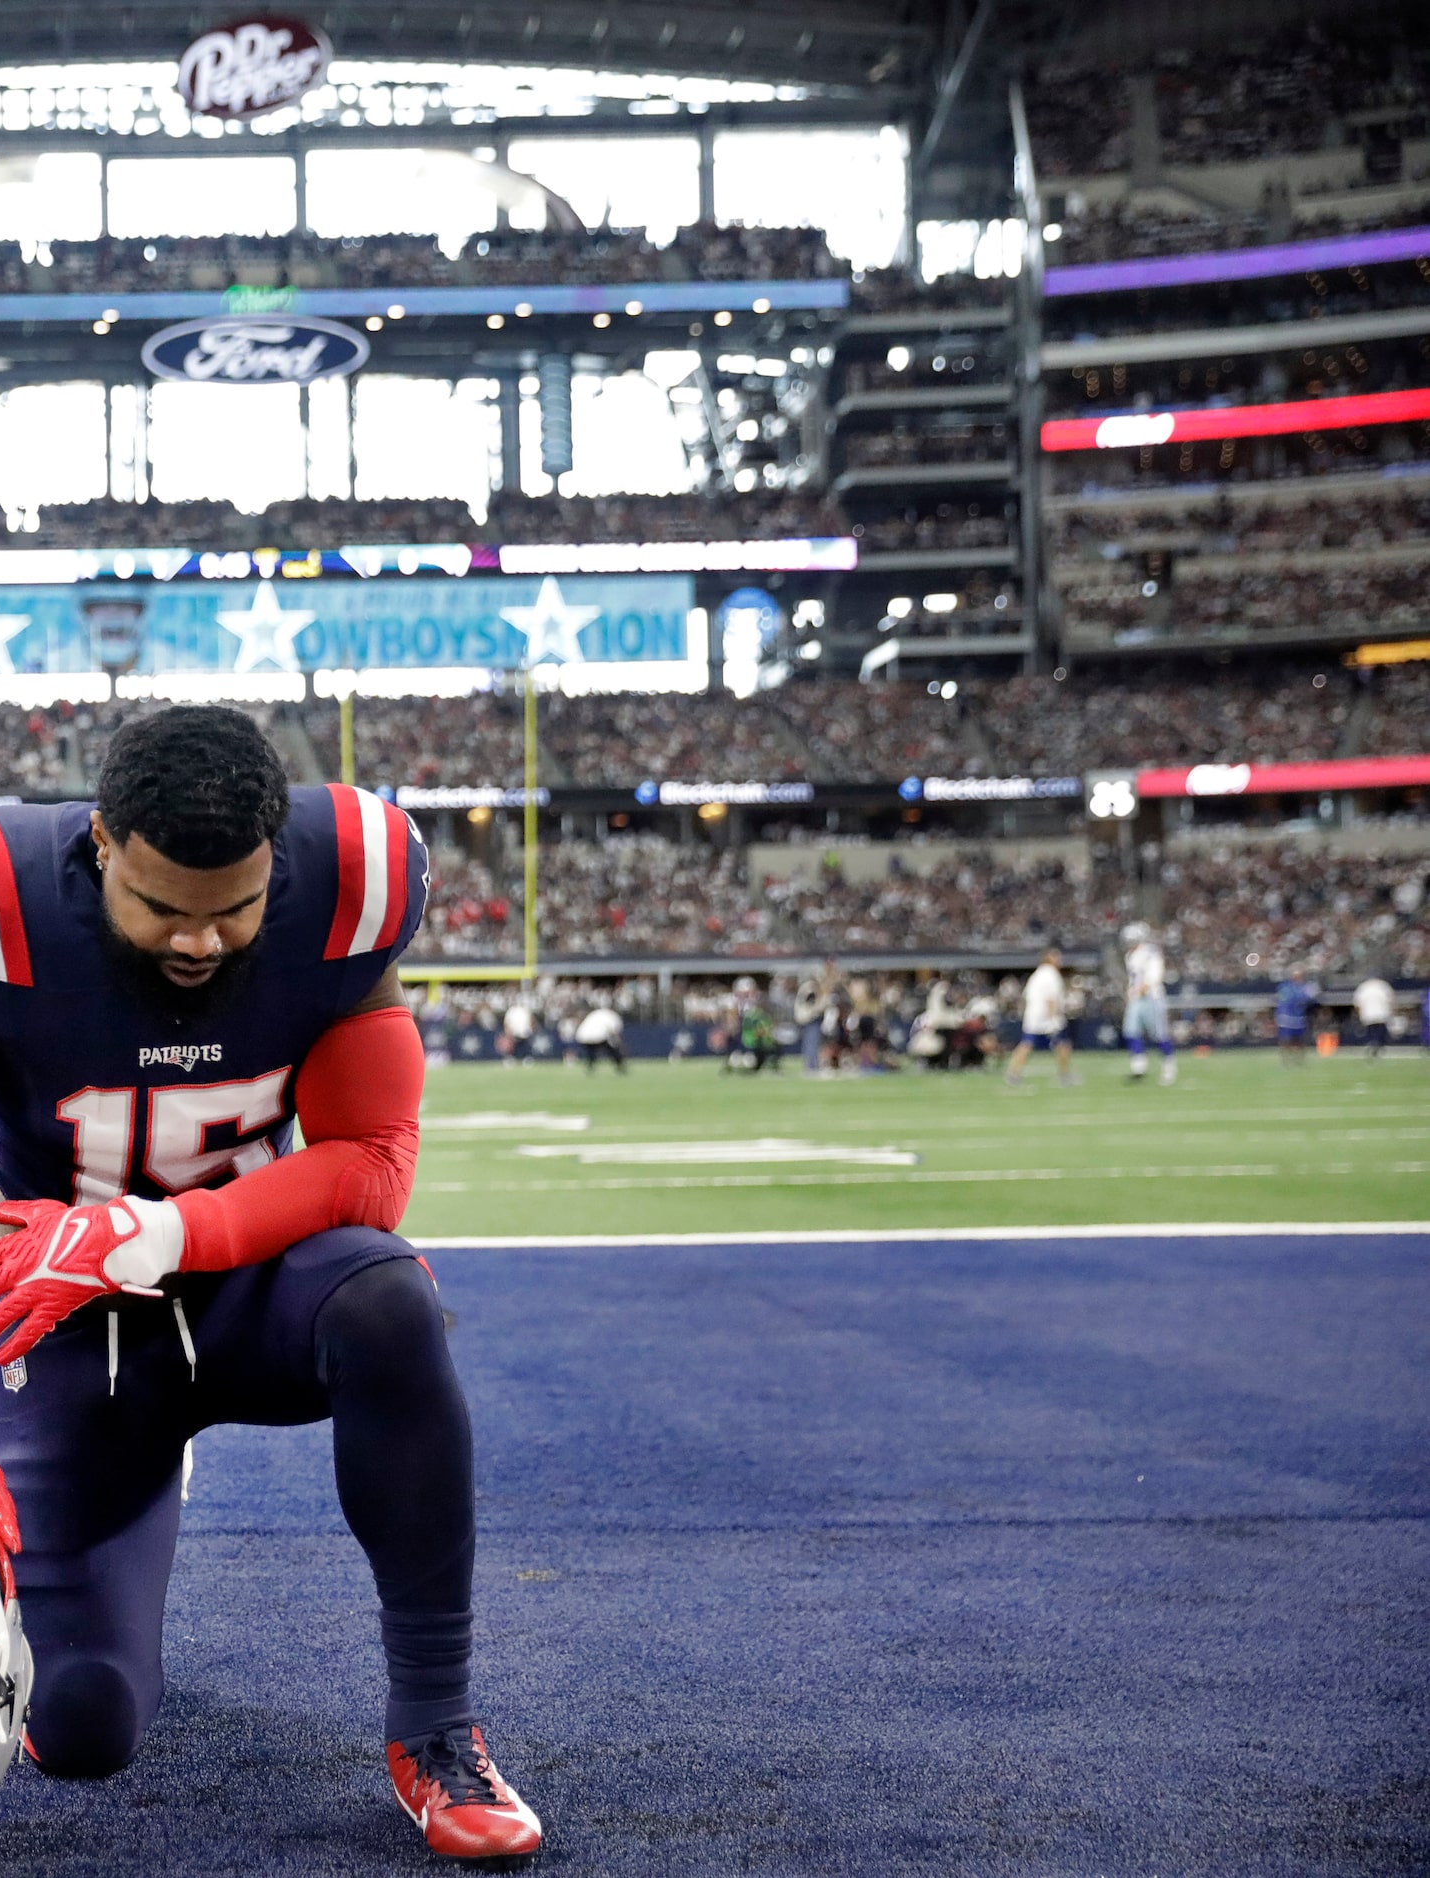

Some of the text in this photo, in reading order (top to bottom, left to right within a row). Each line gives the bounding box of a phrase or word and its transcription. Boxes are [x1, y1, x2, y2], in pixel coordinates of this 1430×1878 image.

[183, 326, 328, 381] Ford
[138, 1043, 223, 1068] PATRIOTS
[56, 1064, 292, 1206] 15
[5, 1368, 24, 1385] NFL
